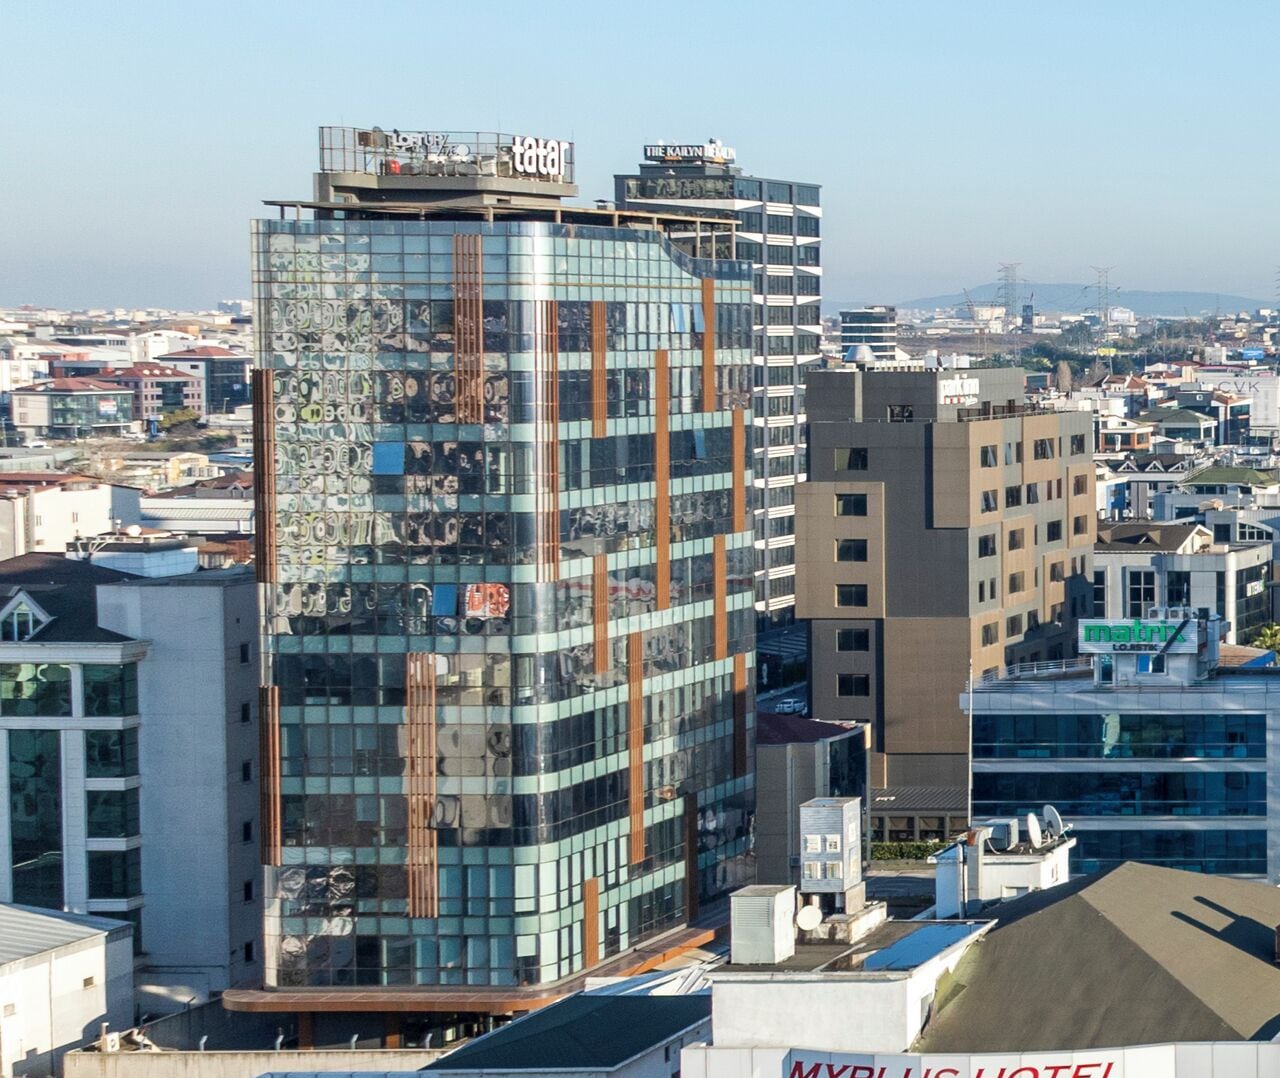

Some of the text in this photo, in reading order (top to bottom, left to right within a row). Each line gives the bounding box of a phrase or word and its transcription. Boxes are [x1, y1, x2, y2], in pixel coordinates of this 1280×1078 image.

[512, 136, 569, 175] tatar
[645, 146, 664, 157] THE
[1218, 381, 1260, 393] CVK
[1083, 619, 1186, 643] matrix
